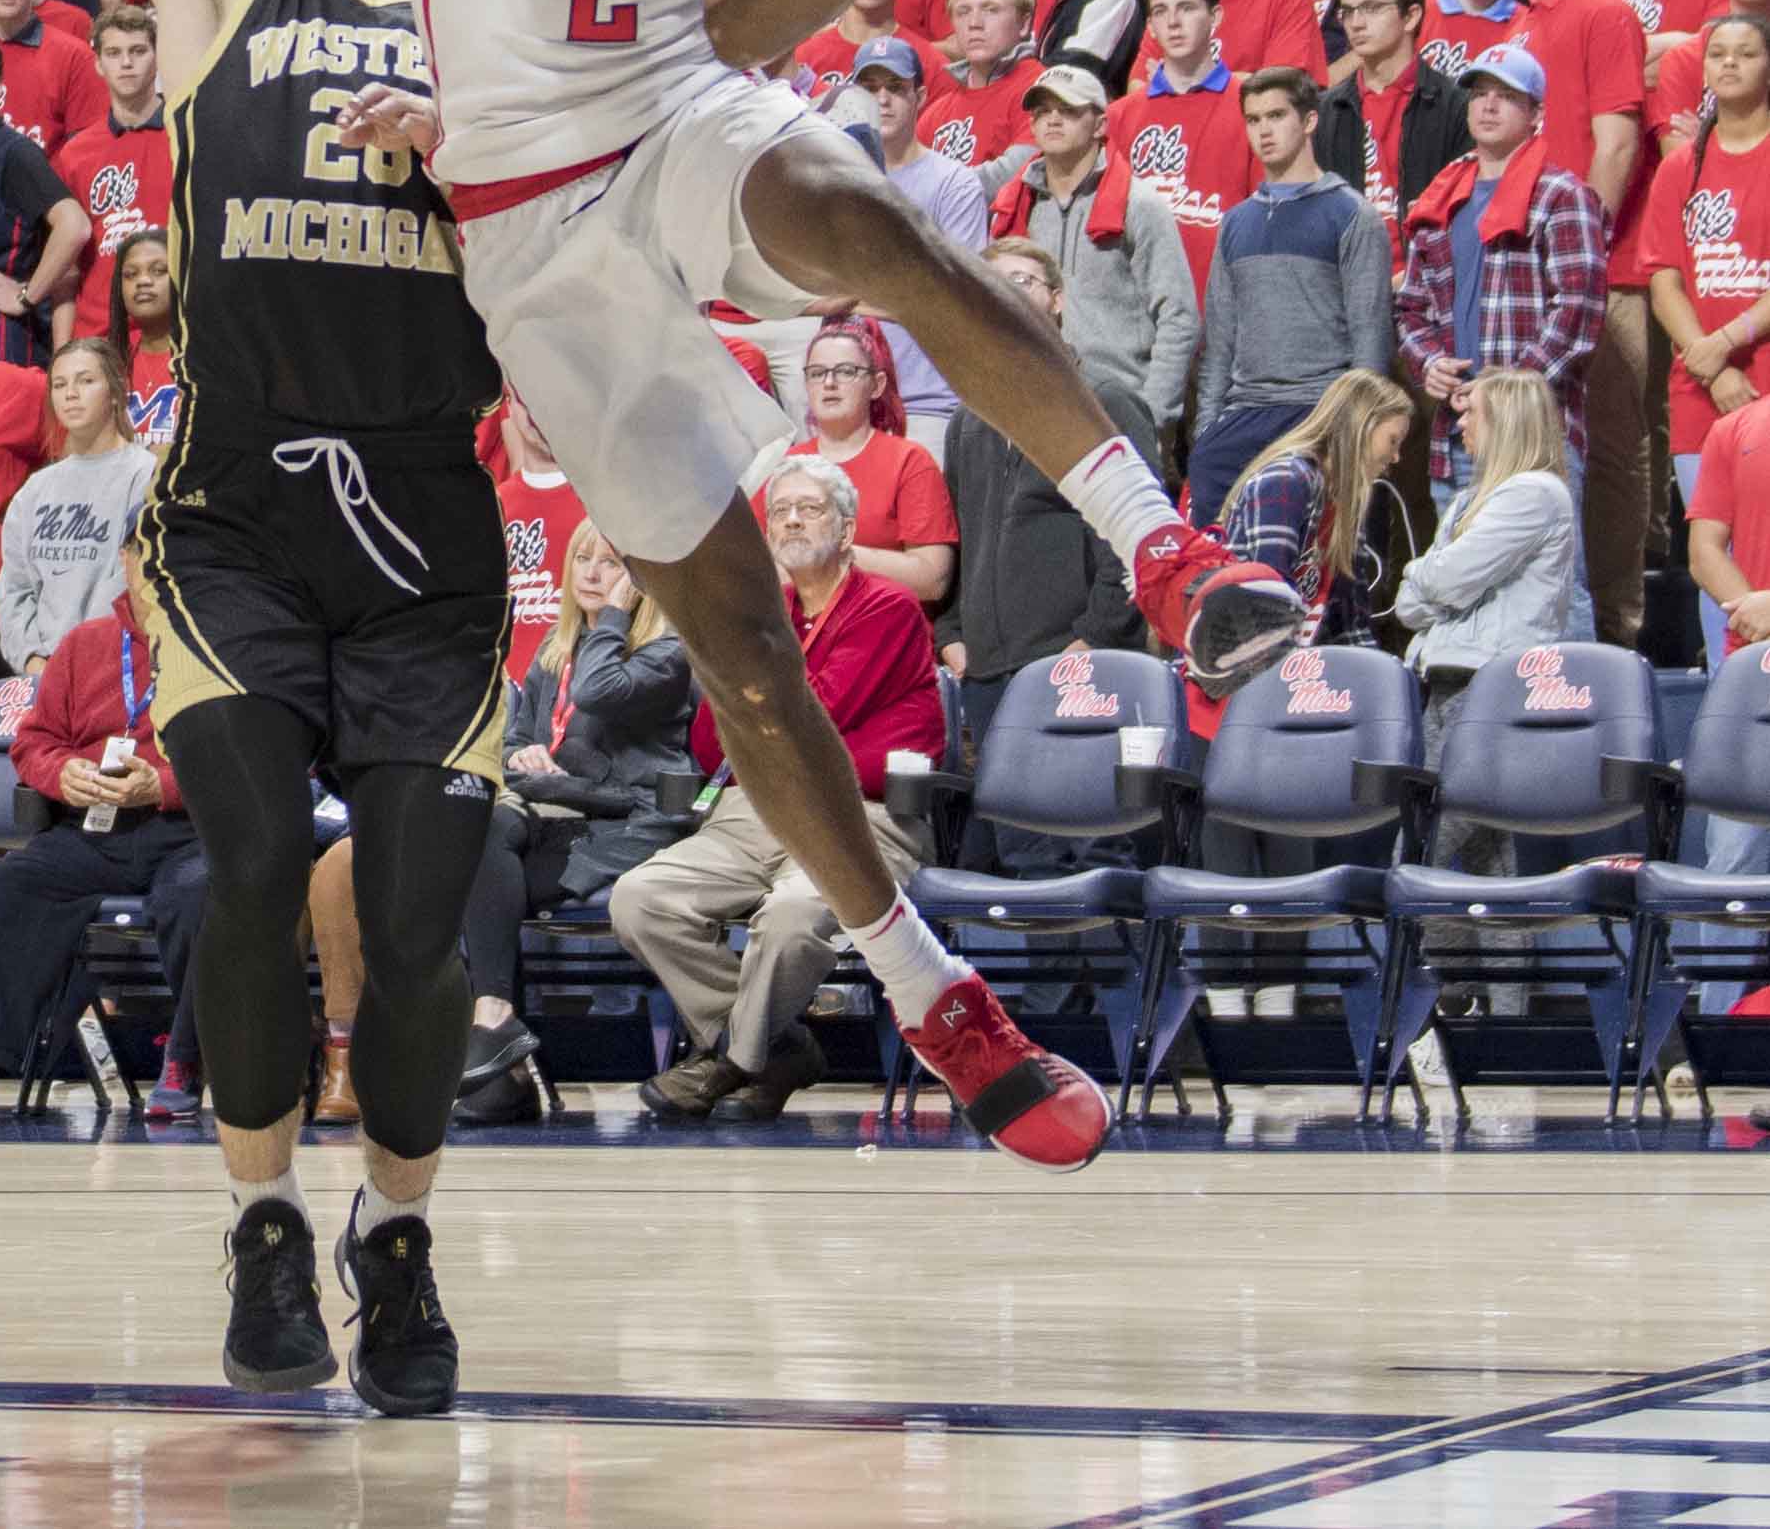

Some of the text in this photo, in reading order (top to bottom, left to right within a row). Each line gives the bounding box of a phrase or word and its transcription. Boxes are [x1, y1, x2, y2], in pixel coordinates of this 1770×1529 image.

[246, 17, 431, 88] WESTE
[1131, 124, 1188, 175] Ole
[90, 161, 138, 213] Ole
[221, 196, 458, 276] MICHIGA
[1050, 653, 1094, 686] Ole
[1280, 648, 1325, 681] Ole
[1517, 646, 1563, 679] Ole
[1056, 683, 1120, 718] Miss
[1287, 678, 1353, 715] Miss
[1526, 675, 1592, 711] Miss
